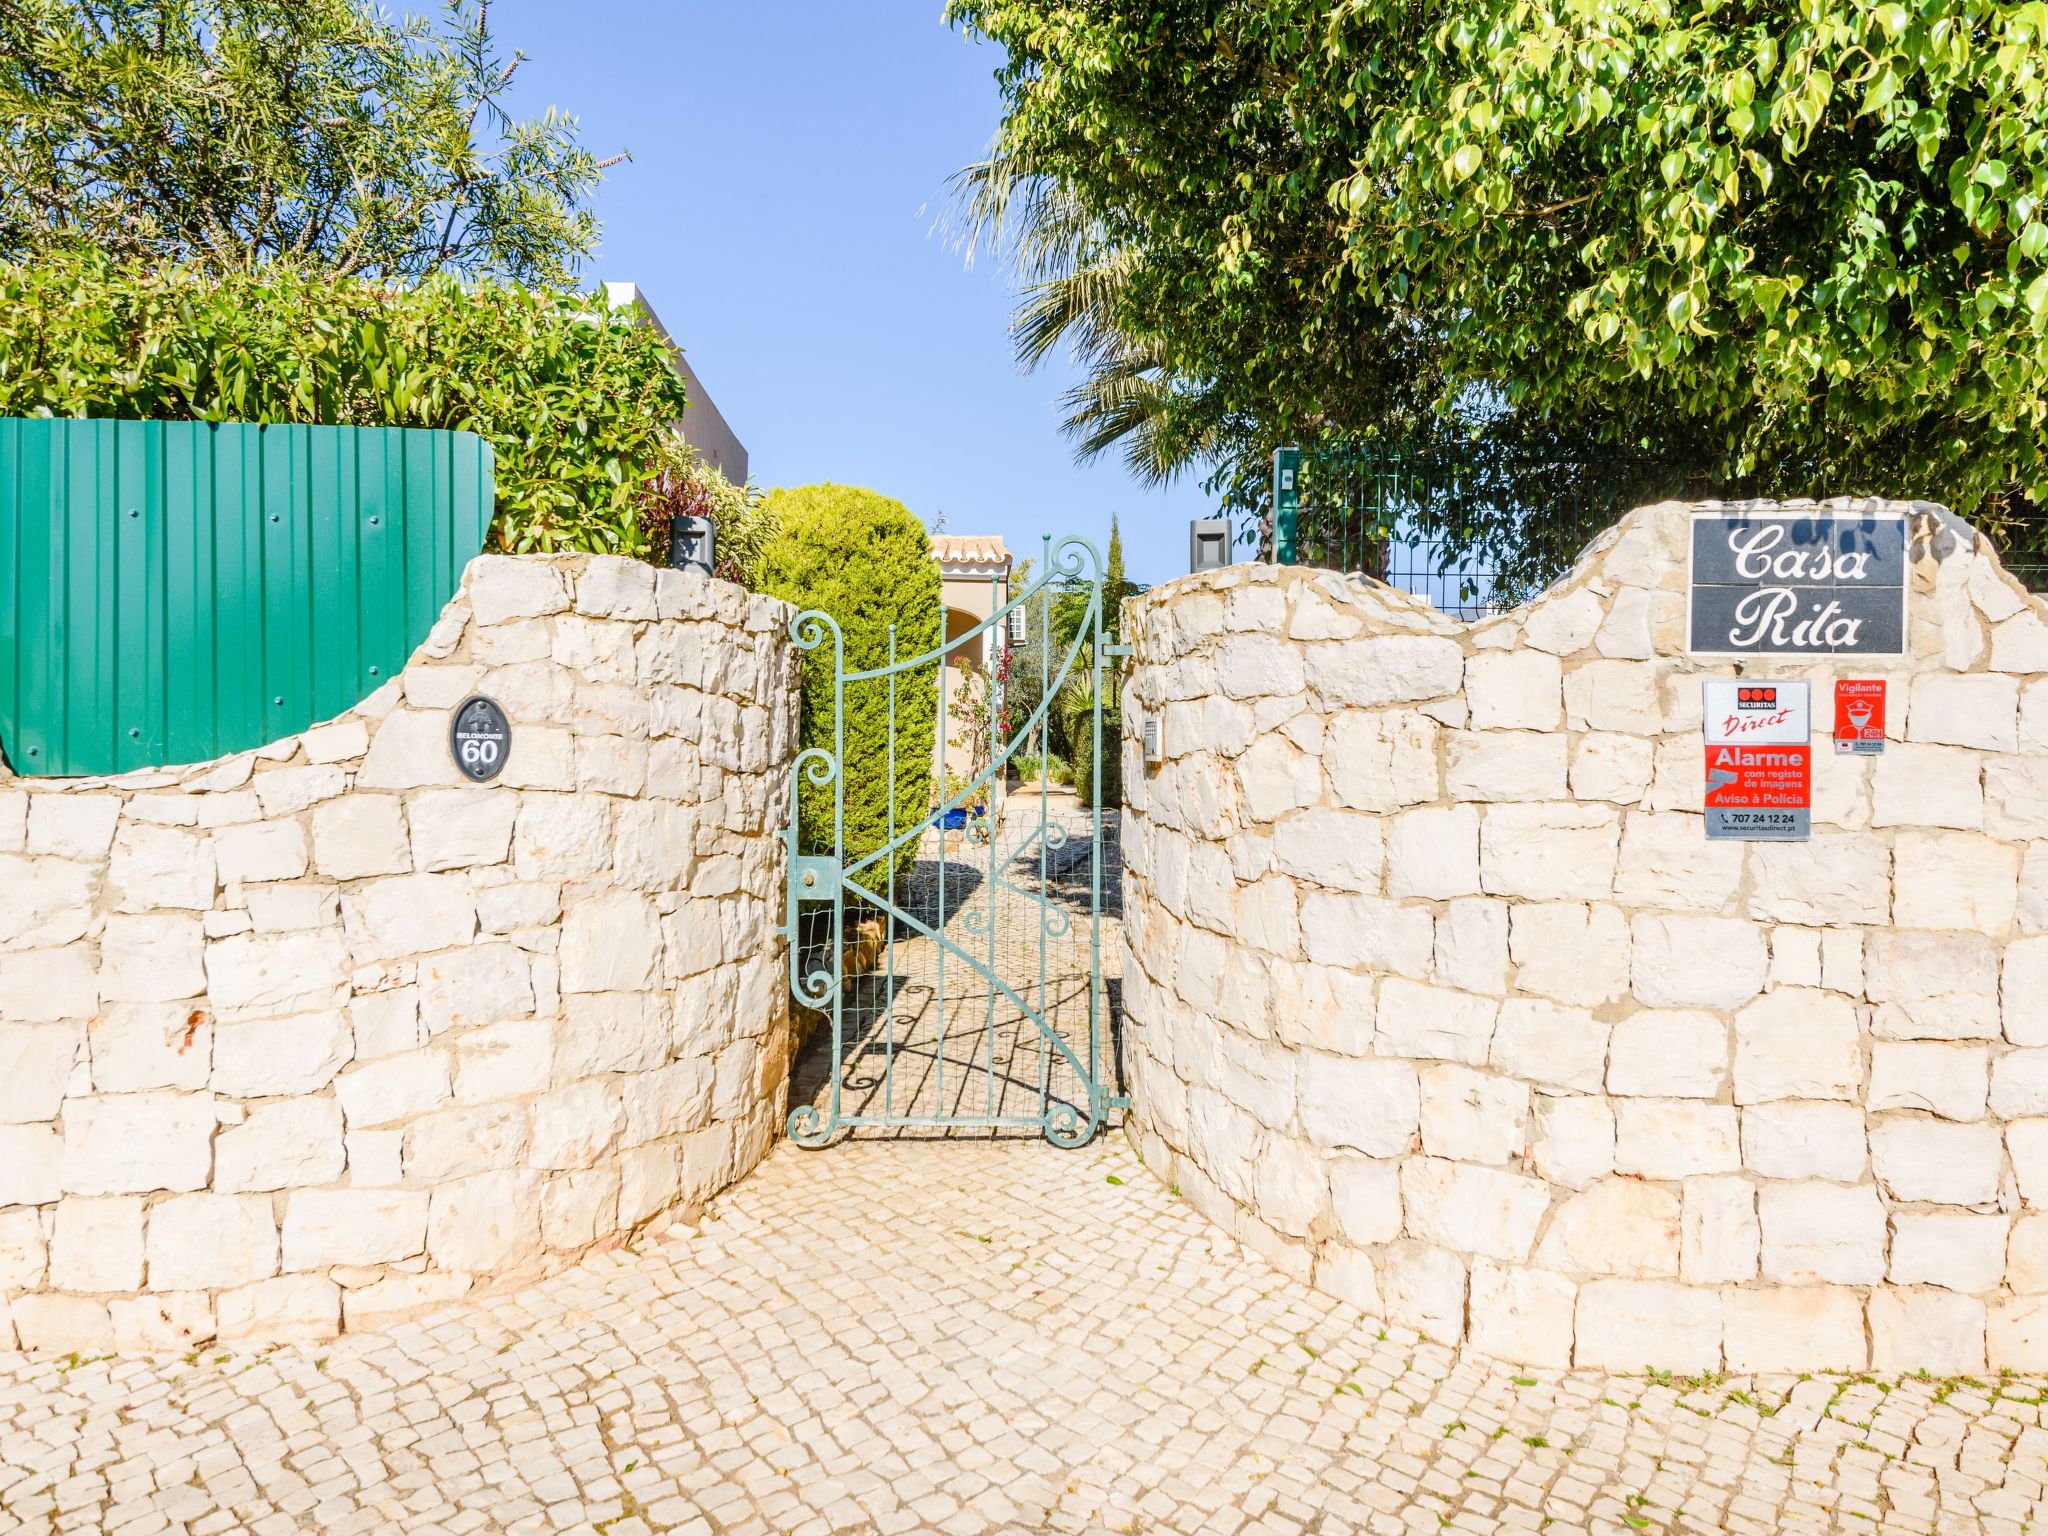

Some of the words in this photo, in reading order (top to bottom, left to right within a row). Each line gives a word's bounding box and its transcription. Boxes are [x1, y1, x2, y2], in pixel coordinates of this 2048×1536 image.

[1728, 524, 1871, 580] Casa
[1729, 586, 1863, 647] Rita
[1839, 684, 1882, 693] Vigilante
[1722, 707, 1795, 737] Direct
[462, 740, 498, 763] 60
[1715, 747, 1804, 767] Alarme
[1768, 770, 1803, 779] registo
[1744, 778, 1758, 788] de
[1760, 778, 1803, 790] imagens
[1715, 793, 1749, 804] Aviso
[1752, 792, 1760, 804] à
[1763, 793, 1804, 804] Polícia
[1732, 814, 1751, 824] 707
[1752, 814, 1765, 824] 24
[1767, 814, 1780, 824] 12
[1782, 814, 1795, 824] 24
